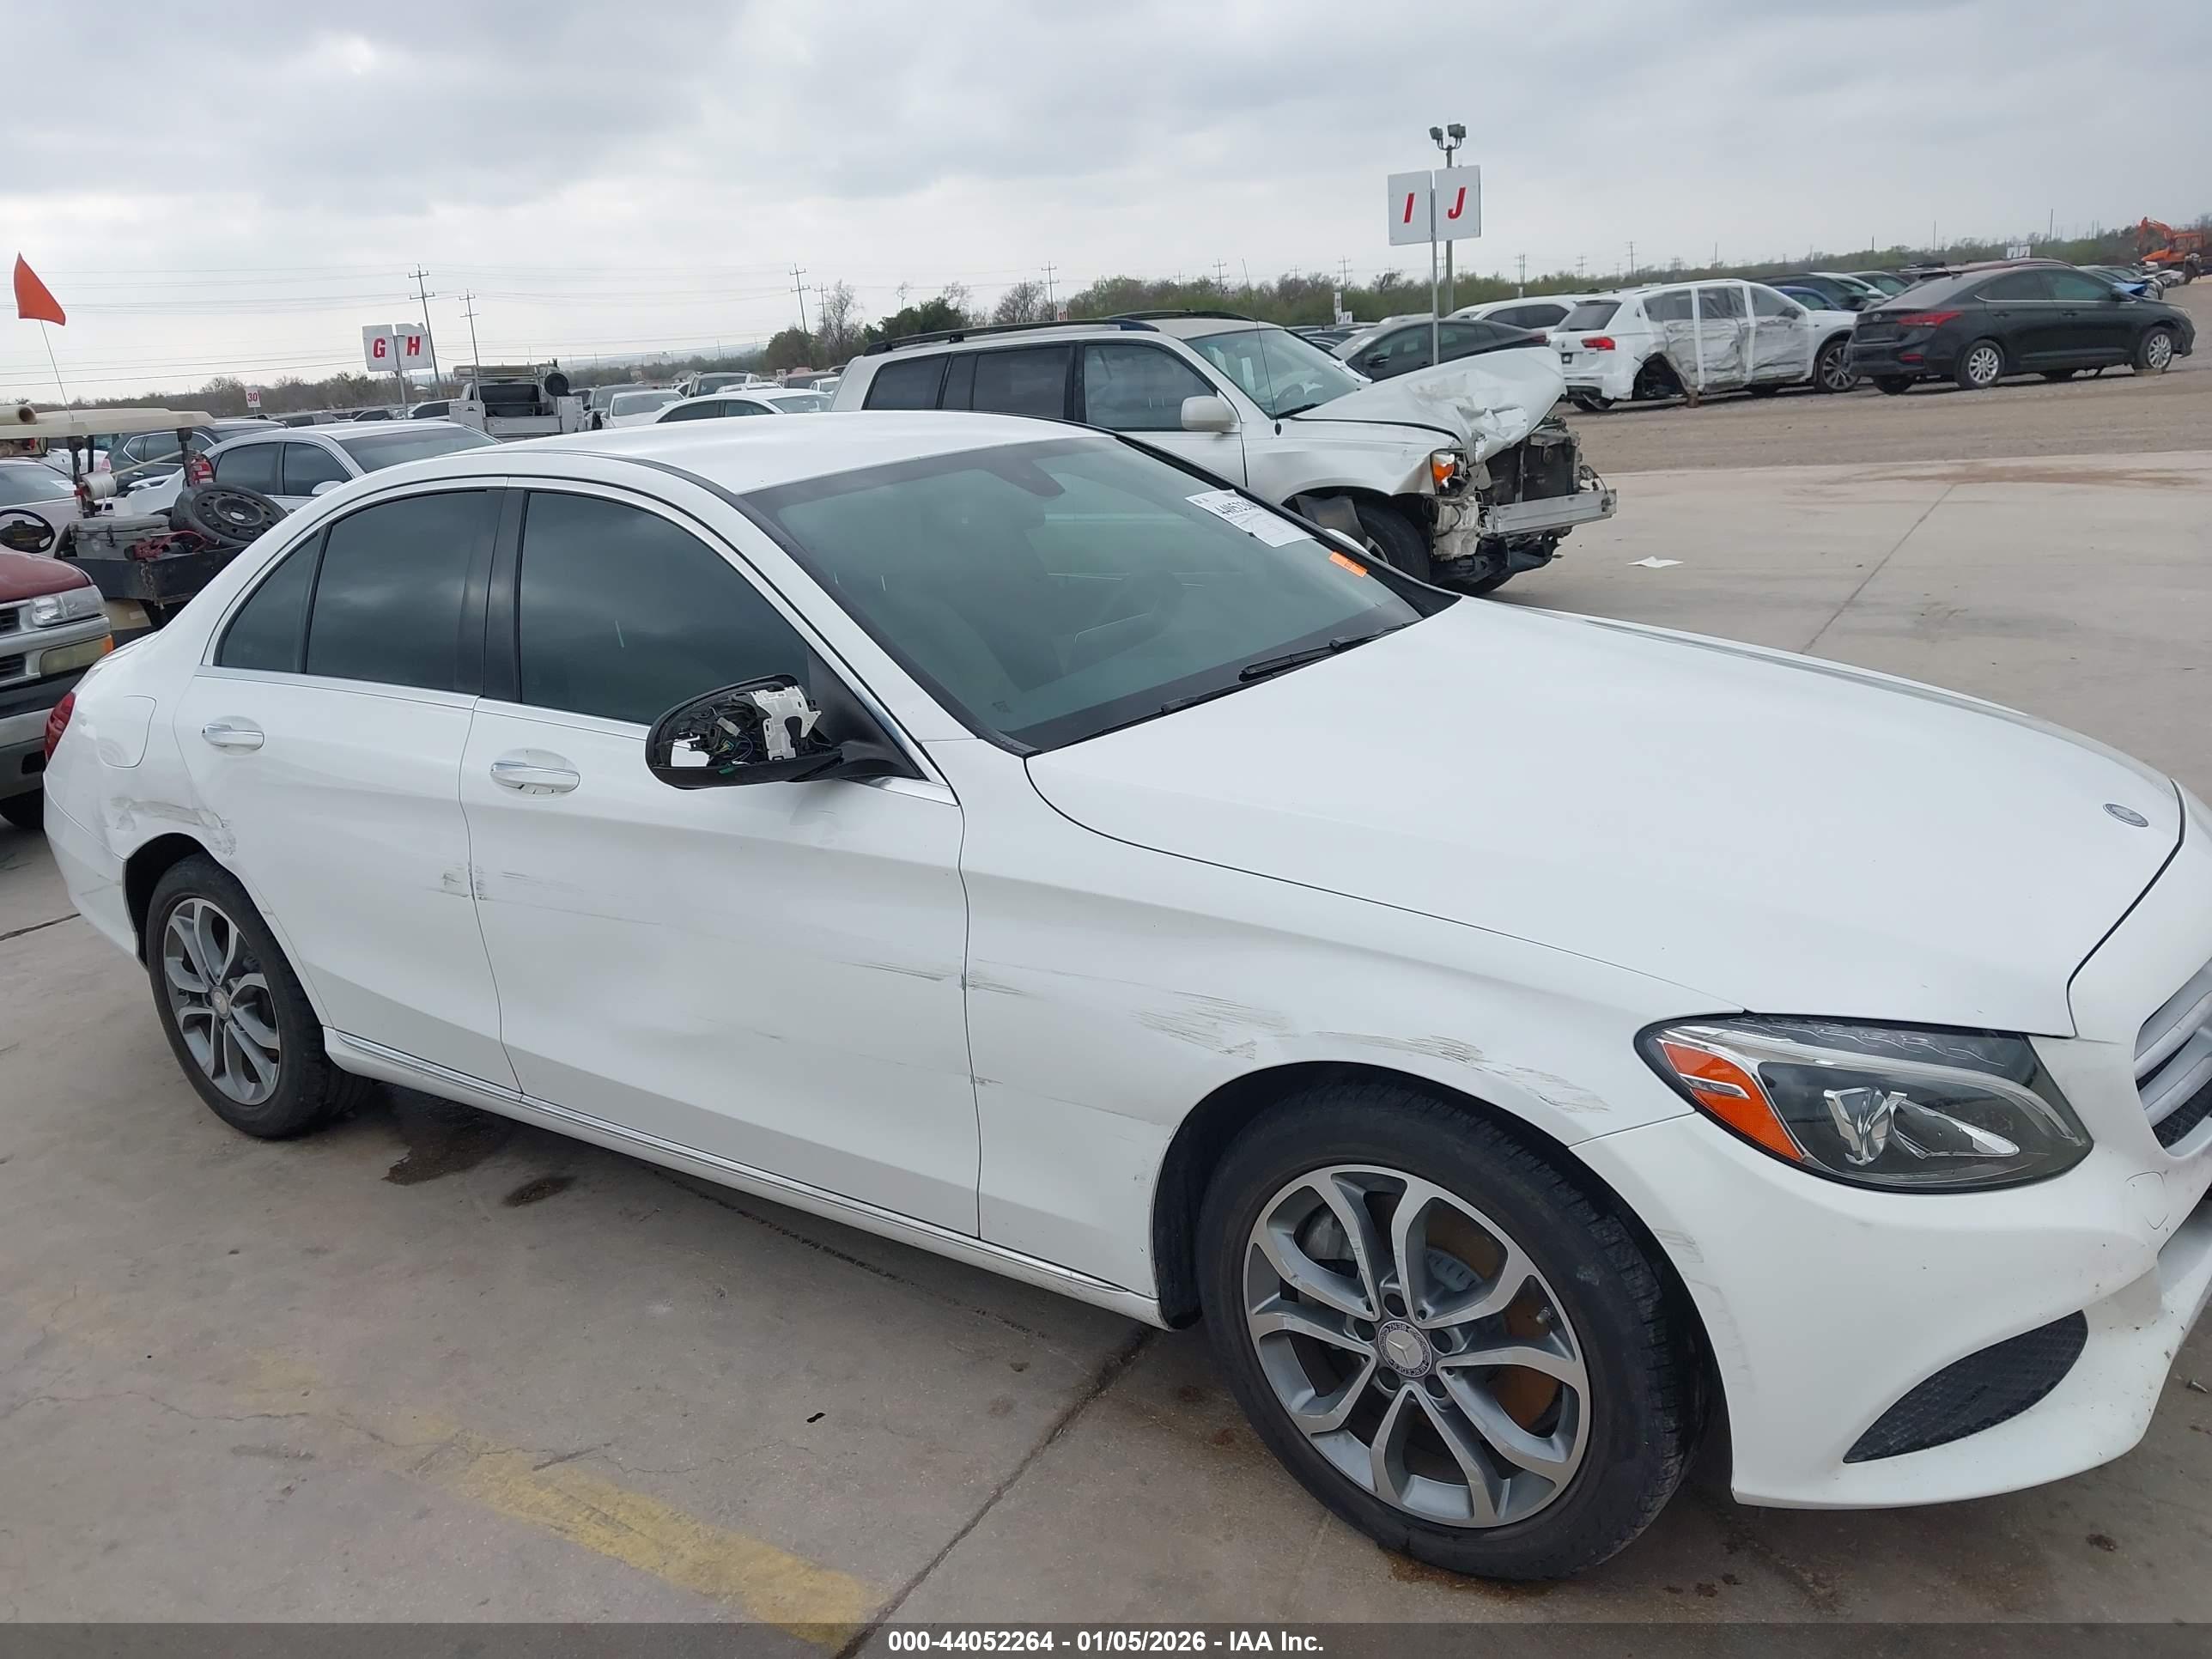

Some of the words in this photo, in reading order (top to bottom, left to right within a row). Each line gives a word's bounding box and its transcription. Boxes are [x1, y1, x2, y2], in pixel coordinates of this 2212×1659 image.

[1403, 191, 1415, 223] I
[1447, 186, 1467, 220] J
[374, 338, 386, 358] G
[407, 336, 421, 356] H
[247, 392, 258, 402] 30
